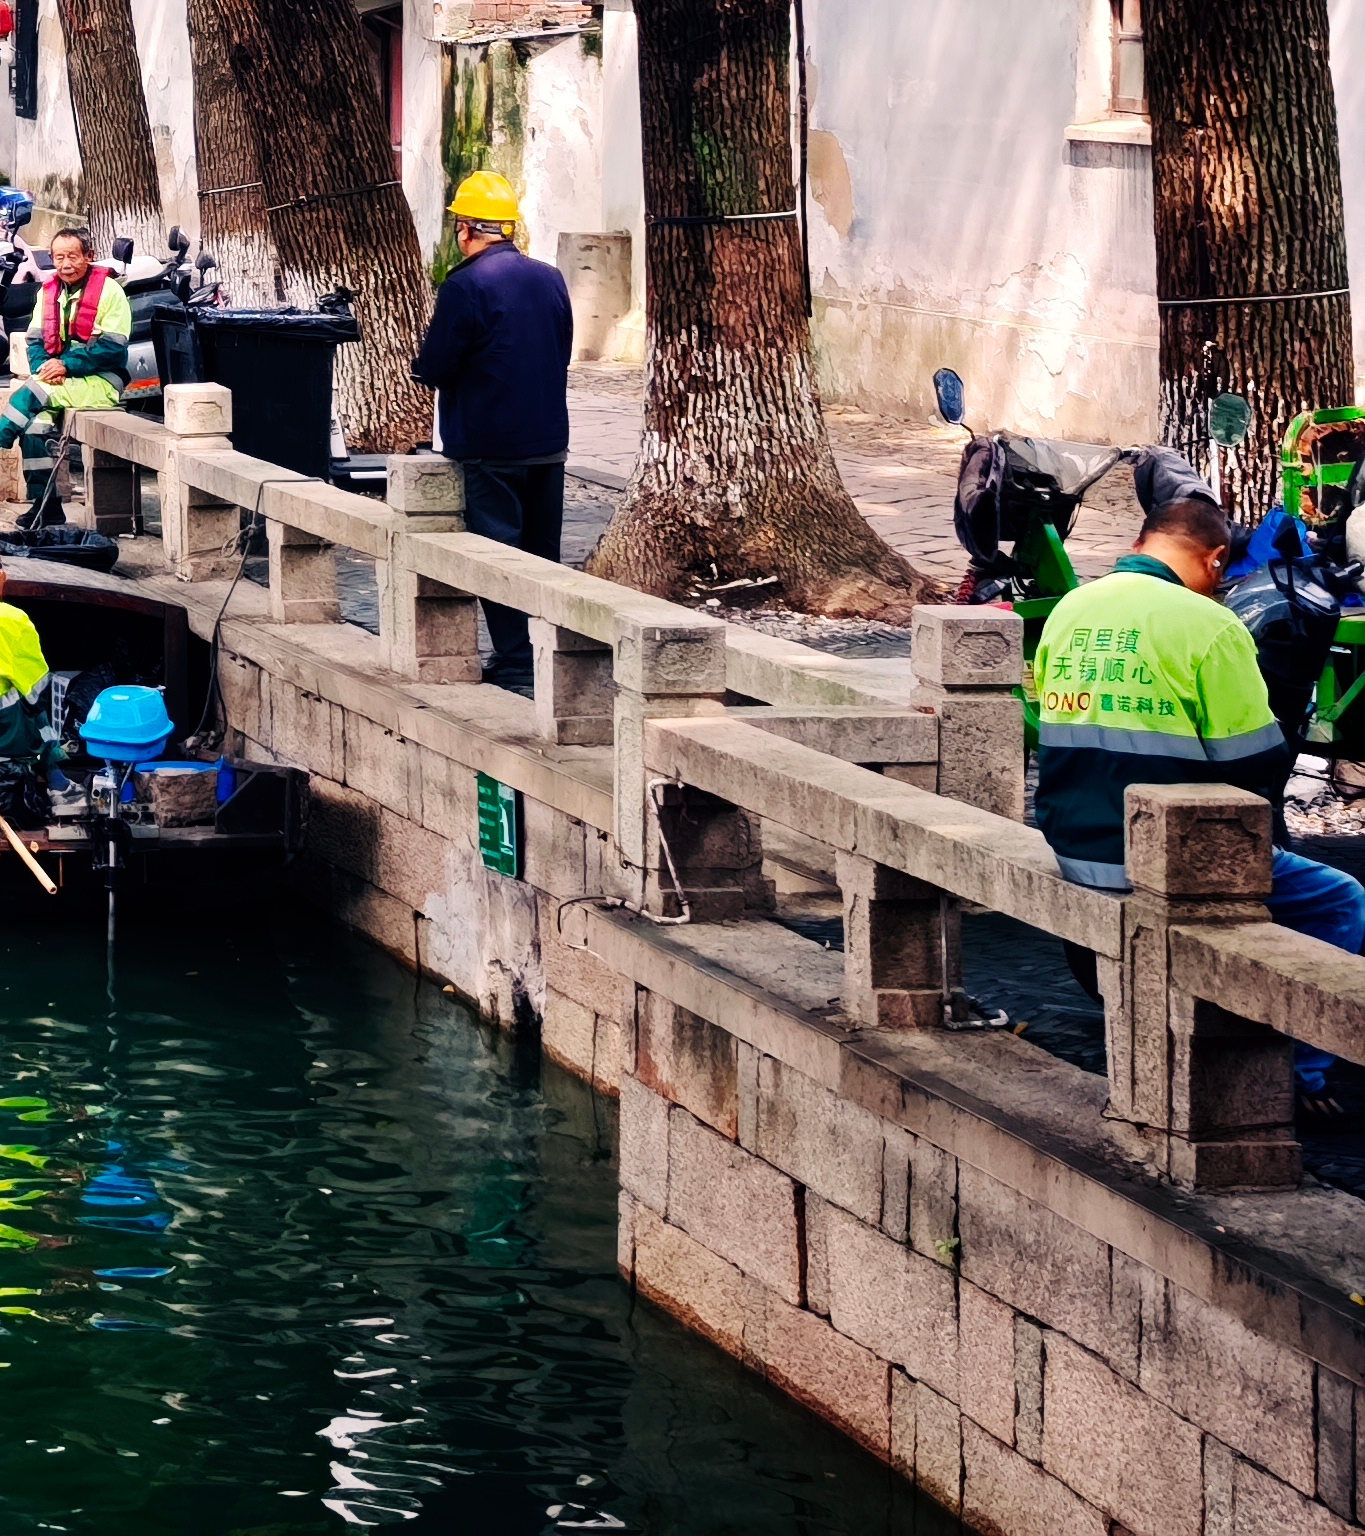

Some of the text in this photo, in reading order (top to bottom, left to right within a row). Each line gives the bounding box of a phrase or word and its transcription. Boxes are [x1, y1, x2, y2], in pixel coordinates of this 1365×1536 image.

[1069, 628, 1141, 654] 同里镇
[1052, 656, 1158, 684] 无锡顺心
